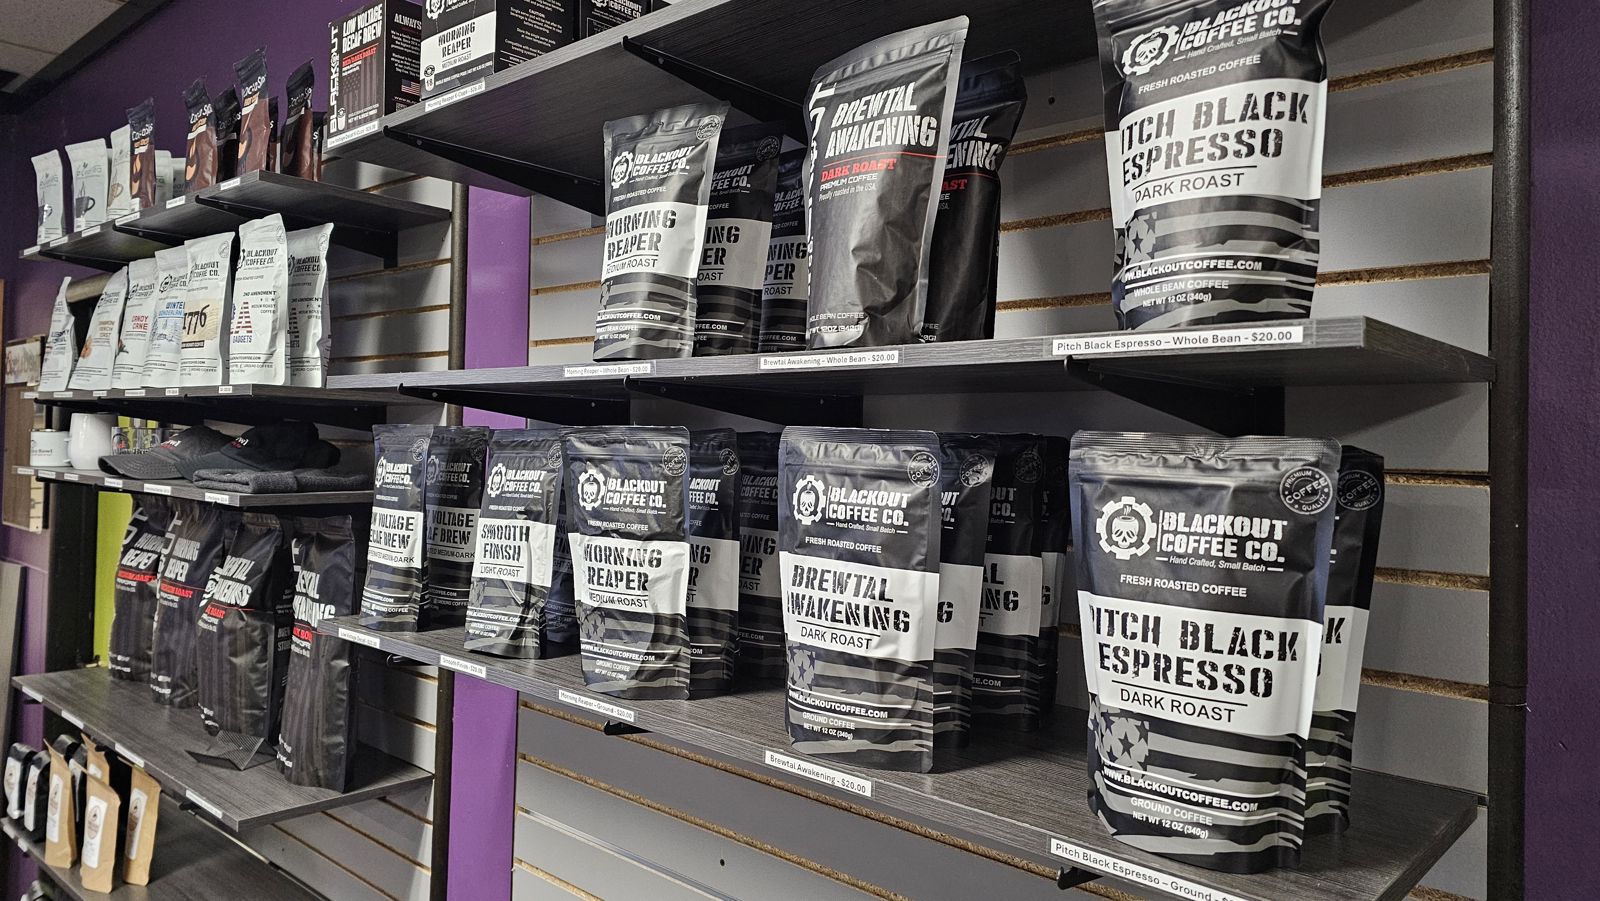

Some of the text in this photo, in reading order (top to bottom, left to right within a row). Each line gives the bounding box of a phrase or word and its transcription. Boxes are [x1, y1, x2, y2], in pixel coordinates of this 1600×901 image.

[610, 1, 632, 15] COFFEE
[1185, 0, 1300, 36] BLACKOU
[343, 17, 357, 37] LOW
[394, 13, 422, 30] ALWAYS
[1180, 6, 1302, 51] COFFEE CO.
[342, 20, 382, 53] DECAF BREW
[438, 22, 475, 46] MORNING
[442, 36, 471, 58] REAPER
[1138, 54, 1261, 94] FRESH ROASTED COFFEE
[831, 82, 918, 128] BREWTAL
[1193, 91, 1310, 130] BLACK
[825, 115, 938, 159] AWAKENING
[636, 146, 695, 164] BLACKOUT
[1122, 128, 1283, 187] ESPRESSO
[633, 158, 690, 176] COFFEE CO.
[821, 158, 897, 182] DARK ROAST
[627, 186, 666, 198] ROASTED COFFEE
[732, 176, 751, 188] CO.
[820, 173, 878, 192] PREMIUM COFFEE
[1134, 173, 1244, 203] DARK ROAST
[247, 249, 278, 257] BLACKOUT
[607, 232, 662, 261] REAPER
[245, 258, 267, 267] COFFEE
[627, 258, 658, 268] ROAST
[209, 269, 219, 277] CO.
[764, 286, 793, 296] ROAST
[1134, 280, 1229, 296] WHOLE BEAN COFFEE
[1177, 294, 1186, 302] OZ
[1187, 292, 1211, 303] (340g)
[183, 304, 210, 335] 1776
[1057, 331, 1292, 351] Pitch Black Espresso Whole Bean $20.00
[763, 358, 786, 366] Brewtal
[787, 357, 821, 367] Awakening
[827, 356, 845, 364] Whole
[872, 353, 895, 362] $20.00
[401, 475, 413, 484] CO.
[459, 473, 470, 483] CO.
[506, 469, 547, 481] BLACKOUT
[1285, 470, 1312, 488] PREMIUM
[504, 481, 542, 493] COFFEE CO.
[608, 478, 667, 494] BLACKOUT
[1286, 477, 1328, 503] COFFEE
[1341, 479, 1375, 503] COFFEE
[606, 492, 667, 508] COFFEE CO.
[705, 492, 719, 505] CO.
[831, 487, 911, 508] BLACKOUT
[1302, 494, 1327, 511] QUALITY
[379, 512, 415, 531] VOLTAGE
[432, 510, 474, 528] VOLTAGE
[829, 504, 909, 526] COFFEE CO.
[481, 523, 530, 543] SMOOTH
[603, 521, 648, 531] ROASTED COFFEE
[1162, 512, 1288, 541] BLACKOUT
[384, 531, 411, 549] BREW
[441, 530, 471, 545] BREW
[805, 537, 881, 553] FRESH ROASTED COFFEE
[483, 543, 521, 563] FINISH
[1162, 534, 1285, 563] COFFEE CO.
[480, 566, 520, 577] LIGHT ROAST
[1169, 555, 1266, 572] Hand Crafted, Small Batch
[587, 566, 649, 592] REAPER
[792, 565, 894, 602] BREWTAL
[1120, 574, 1247, 597] FRESH ROASTED COFFEE
[617, 595, 648, 609] ROAST
[800, 626, 872, 650] DARK ROAST
[1180, 619, 1299, 662] BLACK
[1098, 642, 1273, 698] ESPRESSO
[1120, 688, 1235, 723] DARK ROAST
[802, 711, 855, 730] GROUND COFFEE
[770, 754, 866, 794] Brewtal Awakening $20.00
[1130, 796, 1213, 826] GROUND COFFEE
[1133, 811, 1209, 839] NET WT 12 OZ (340g)
[1055, 843, 1212, 901] Pitch Black Espresso Ground
